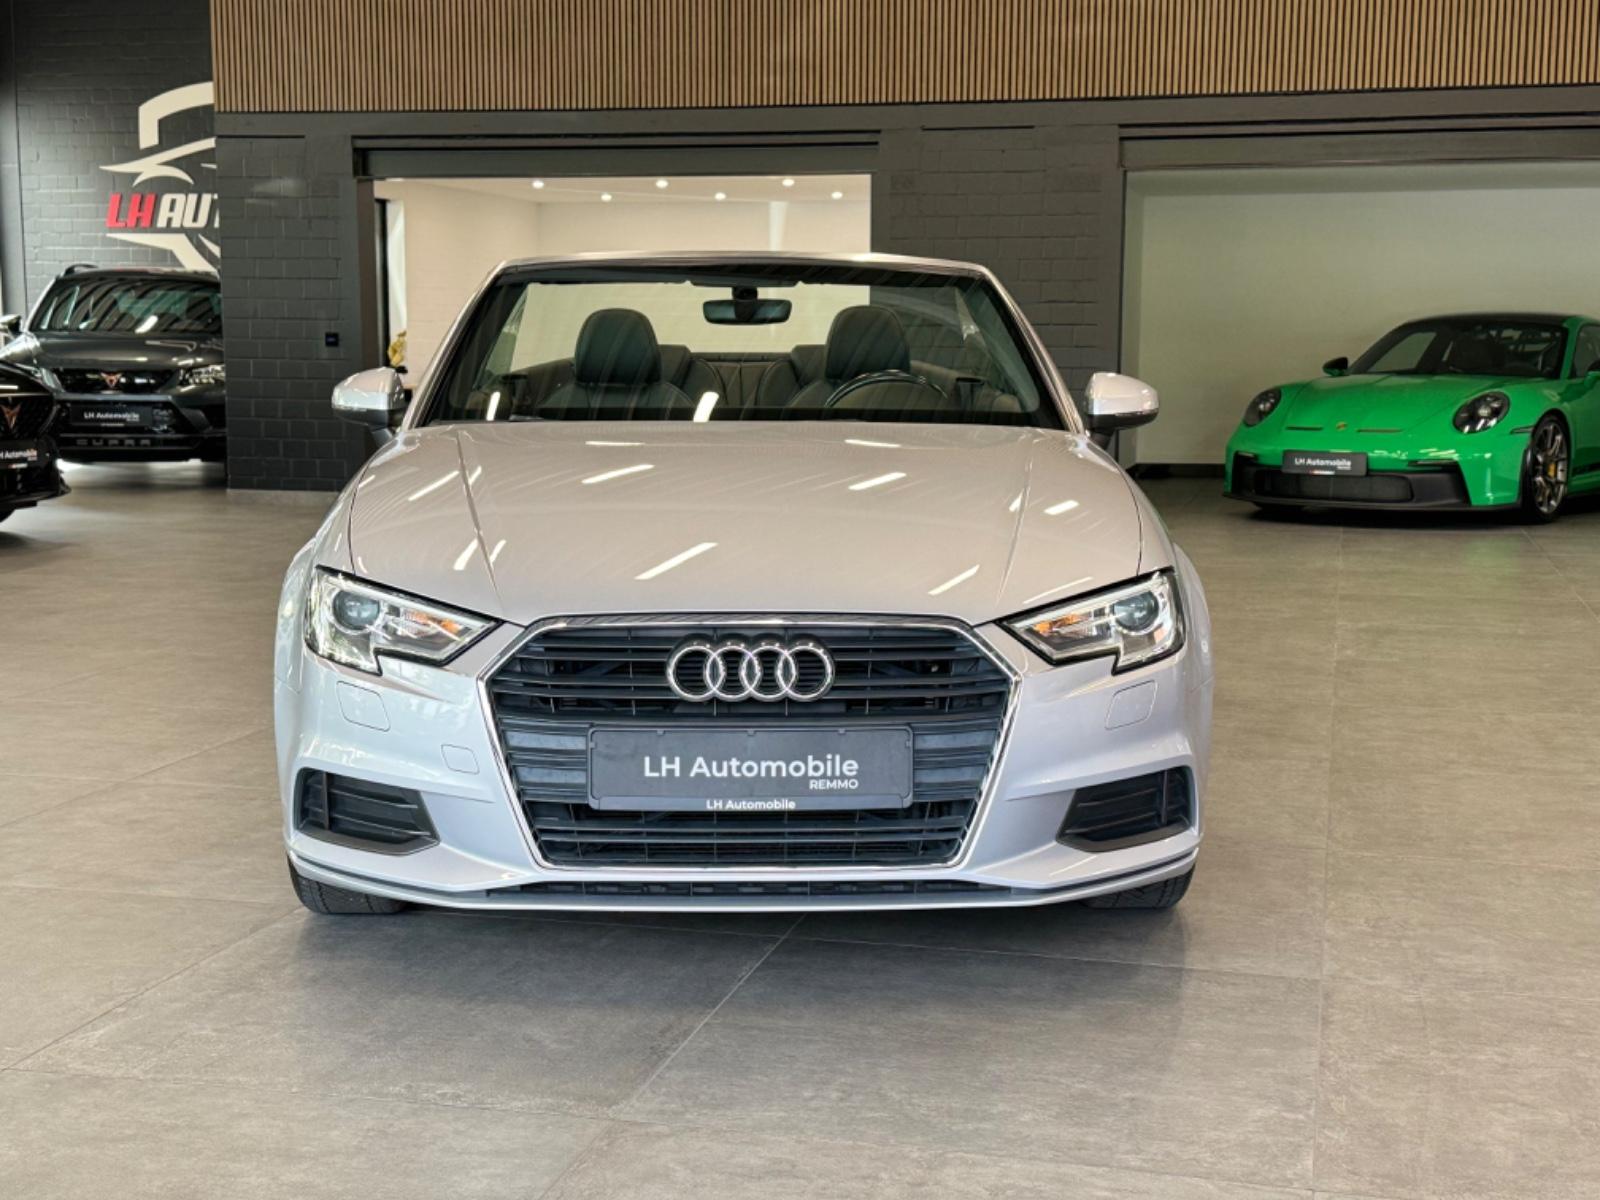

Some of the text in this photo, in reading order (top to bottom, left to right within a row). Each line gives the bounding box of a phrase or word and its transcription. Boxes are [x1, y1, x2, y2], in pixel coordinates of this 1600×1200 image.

[106, 192, 156, 228] LH
[83, 411, 140, 419] LH Automobile
[1294, 457, 1352, 466] LH Automobile
[644, 753, 860, 778] LH Automobile
[809, 778, 859, 790] REMMO
[706, 799, 796, 811] LH Automobile
